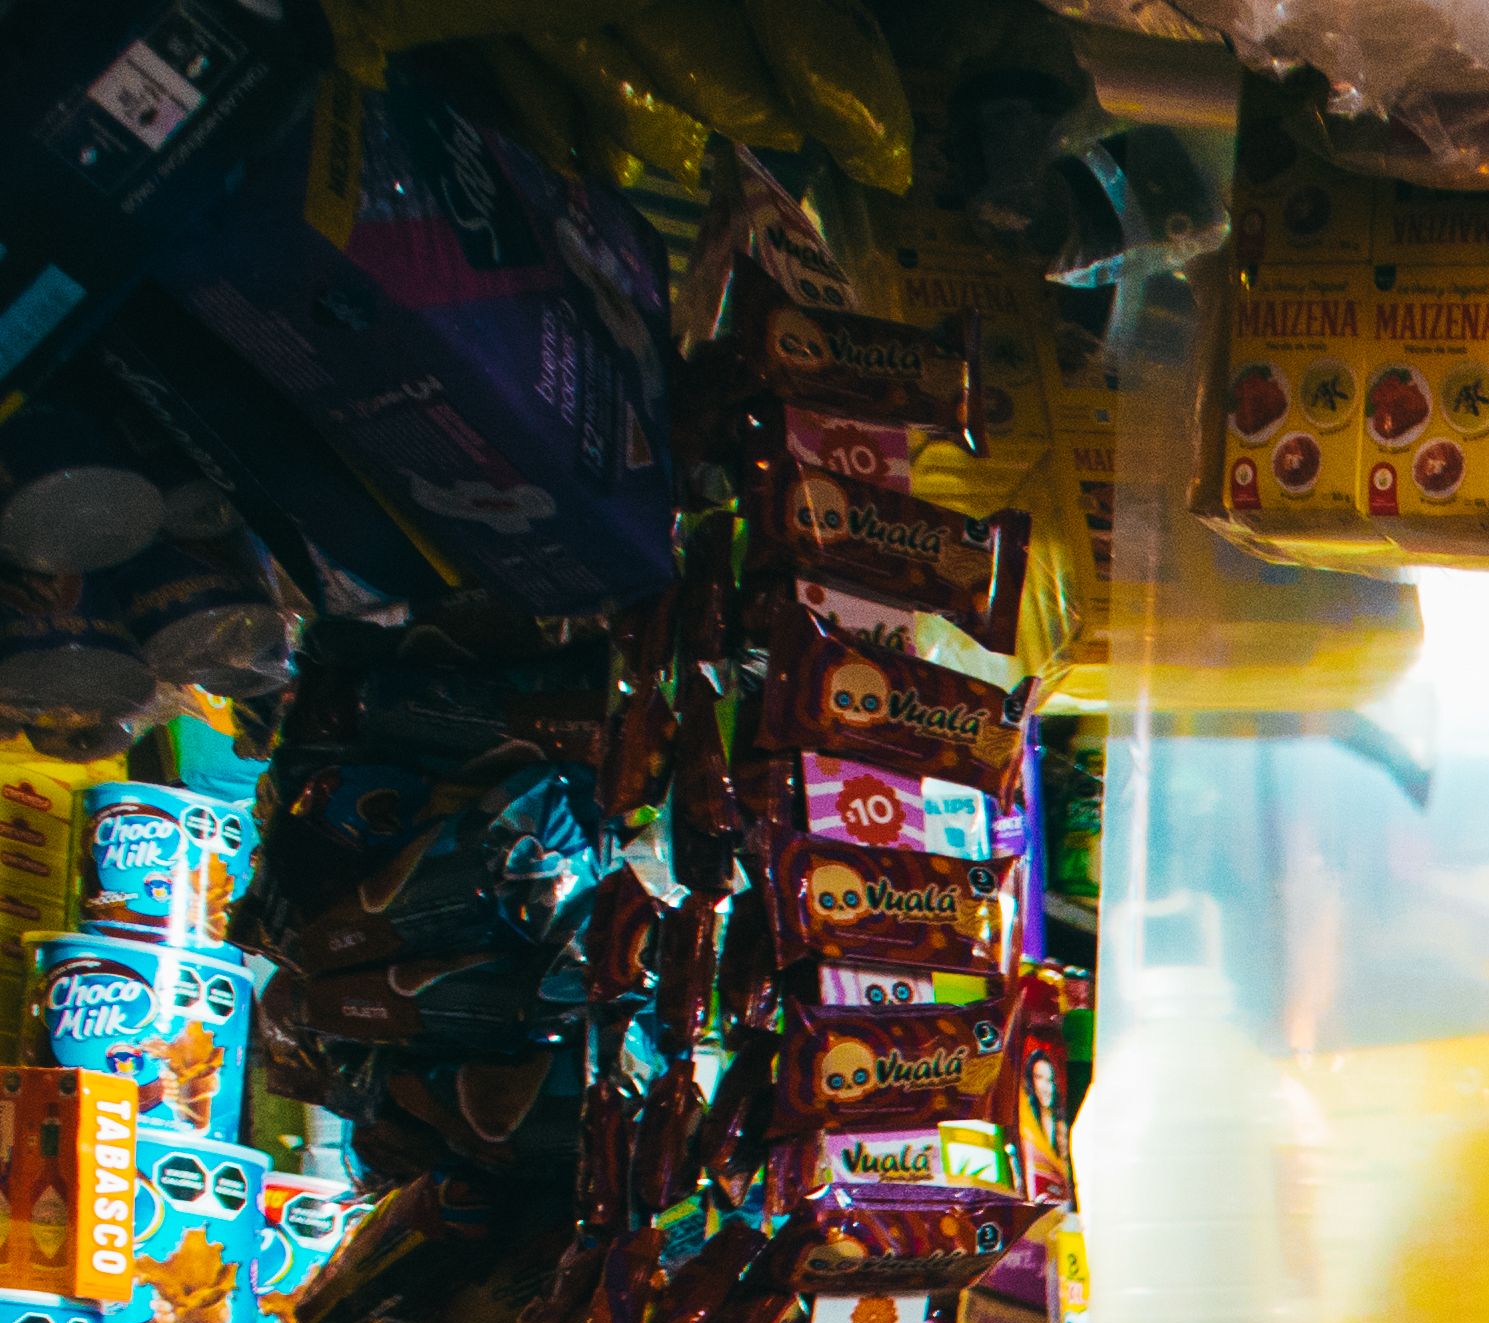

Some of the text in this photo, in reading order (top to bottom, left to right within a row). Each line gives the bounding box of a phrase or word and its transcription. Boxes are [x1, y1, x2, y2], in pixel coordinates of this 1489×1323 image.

[1239, 301, 1358, 338] MAIZENA
[848, 508, 946, 553] Vualá
[889, 690, 985, 740] Vualá
[91, 815, 178, 848] Choco
[104, 837, 169, 871] Milk
[866, 880, 958, 918] Vualá
[48, 973, 147, 1011] Choco
[54, 1005, 130, 1040] Milk
[874, 1045, 963, 1091] Vualá
[842, 1140, 934, 1182] Vualá
[90, 1099, 131, 1277] TABASCO
